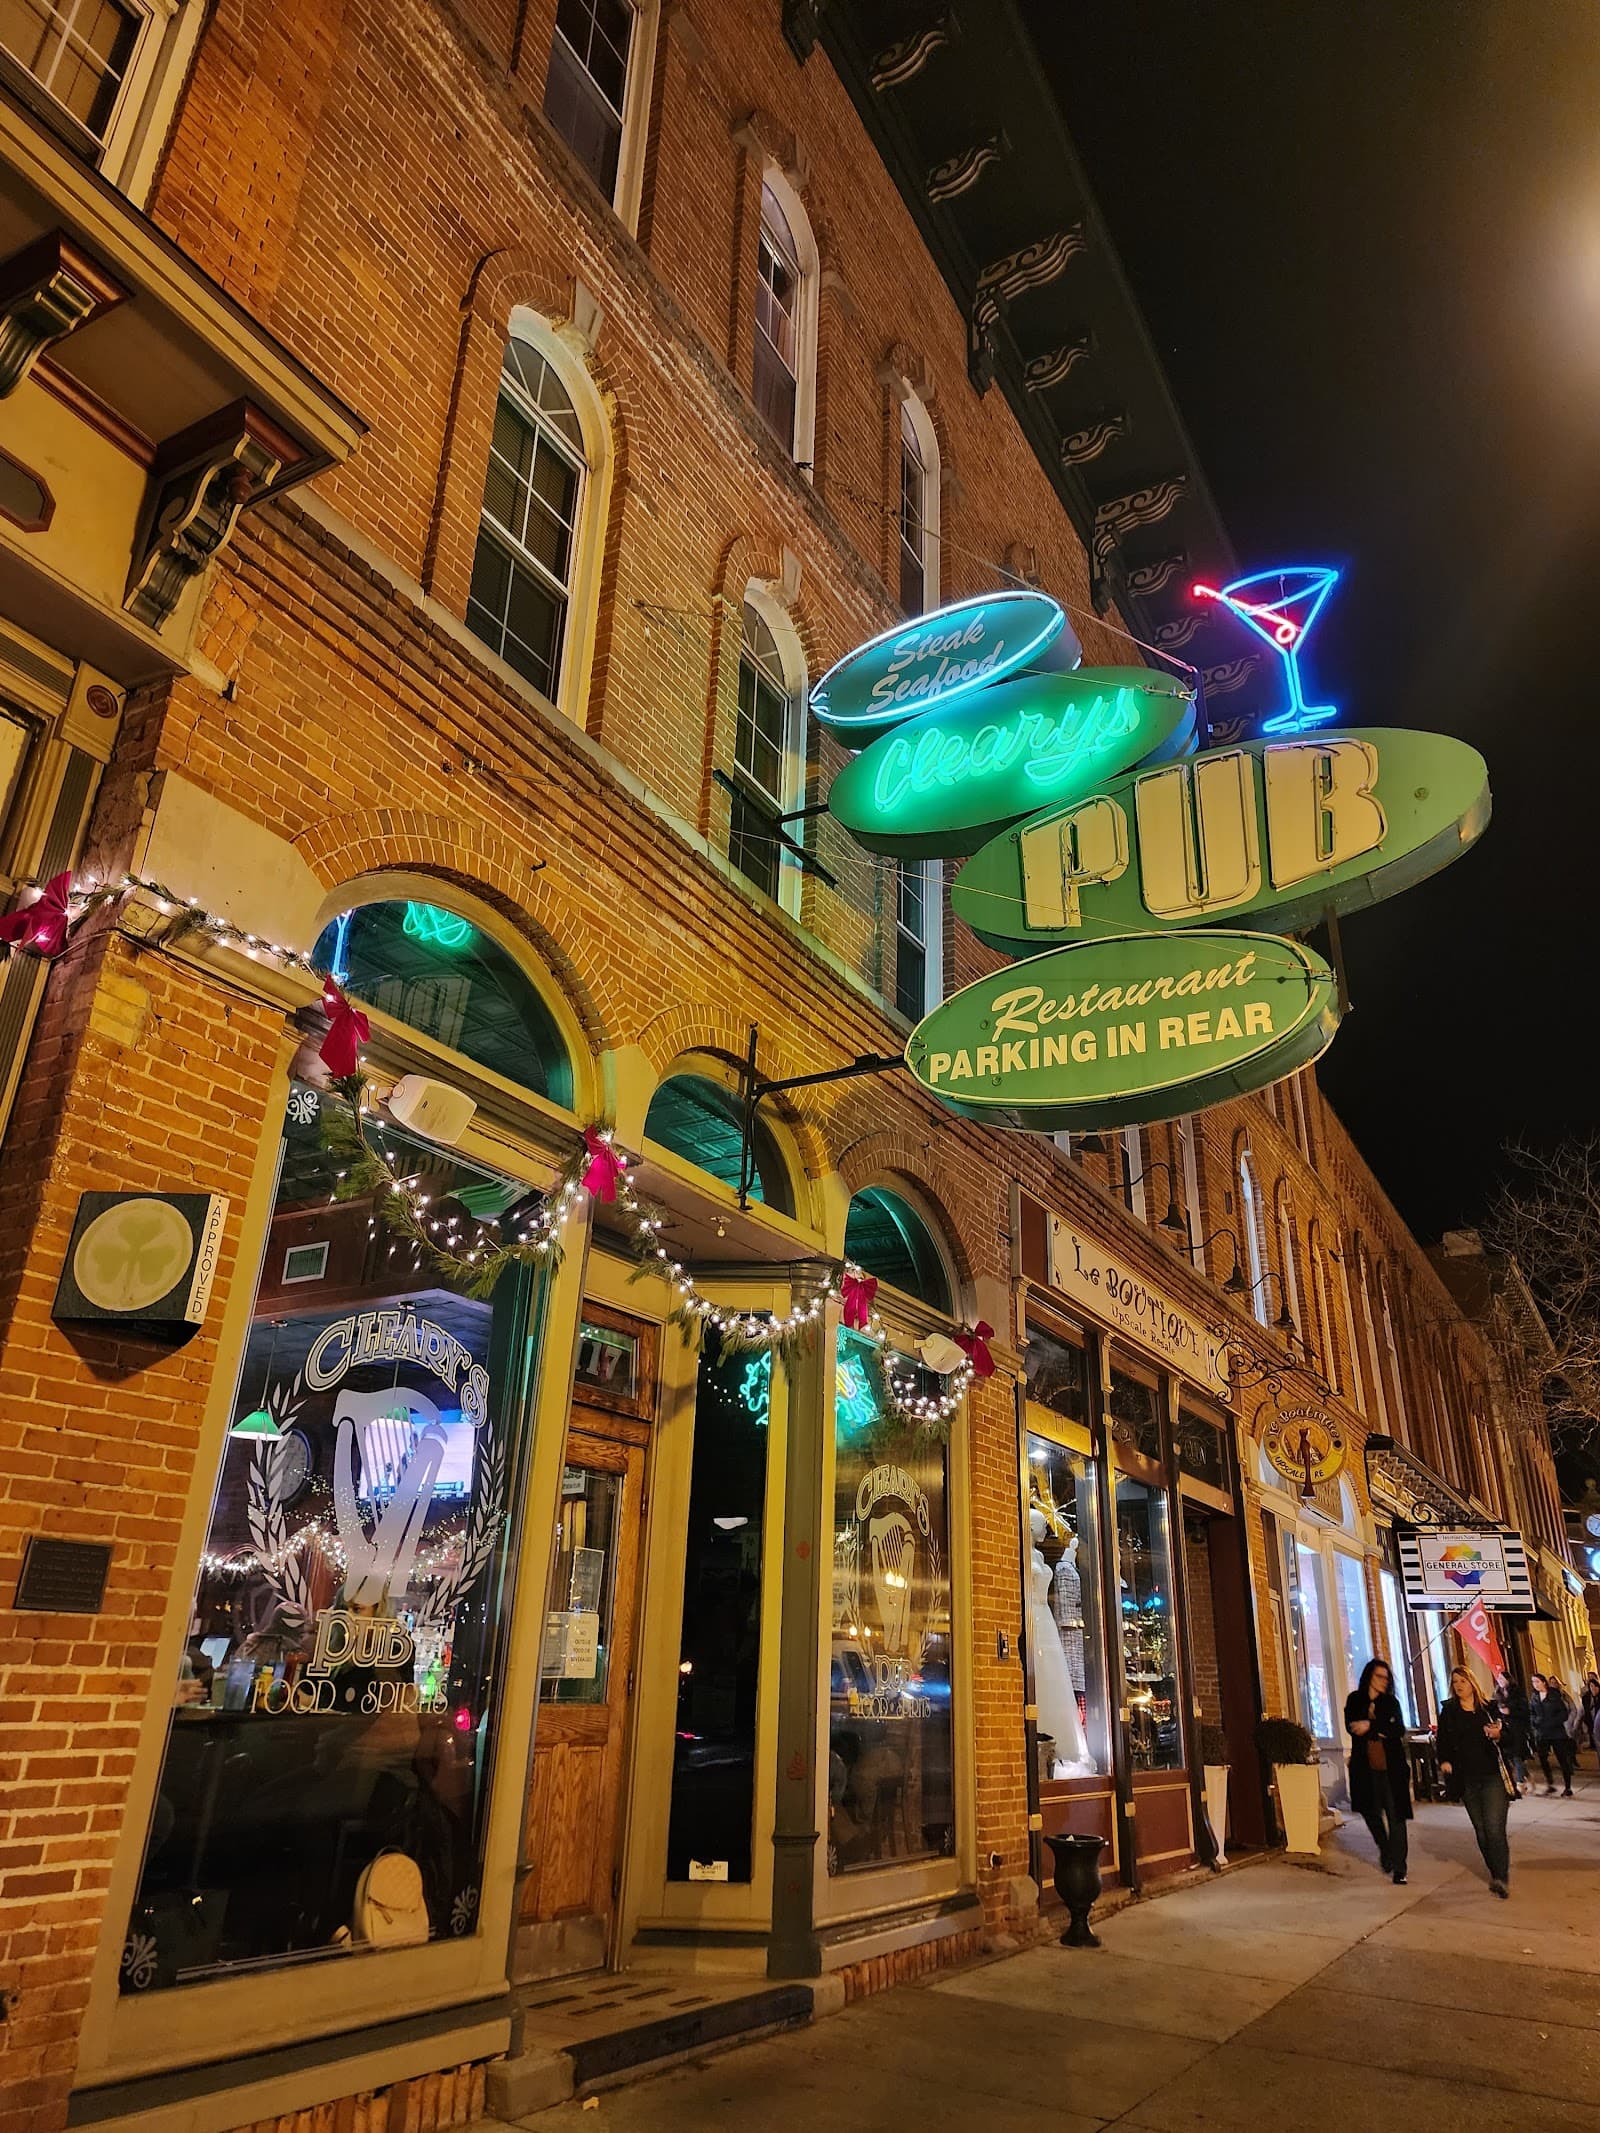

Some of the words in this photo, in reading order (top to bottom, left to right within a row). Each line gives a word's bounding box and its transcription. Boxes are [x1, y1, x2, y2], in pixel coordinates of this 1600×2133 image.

[867, 639, 1003, 712] Seafood
[888, 610, 986, 673] Steak
[1020, 738, 1388, 930] PUB
[991, 950, 1255, 1041] Restaurant
[929, 1027, 1098, 1082] PARKING
[1107, 1022, 1147, 1057] IN
[1160, 1001, 1273, 1049] REAR
[191, 1206, 221, 1314] APPROVED
[1071, 1236, 1100, 1286] Le
[305, 1311, 490, 1427] CLEARY'S
[1426, 1561, 1468, 1569] GENERAL
[1471, 1560, 1500, 1569] STORE
[307, 1609, 413, 1677] PUB
[249, 1680, 336, 1714] FOOD
